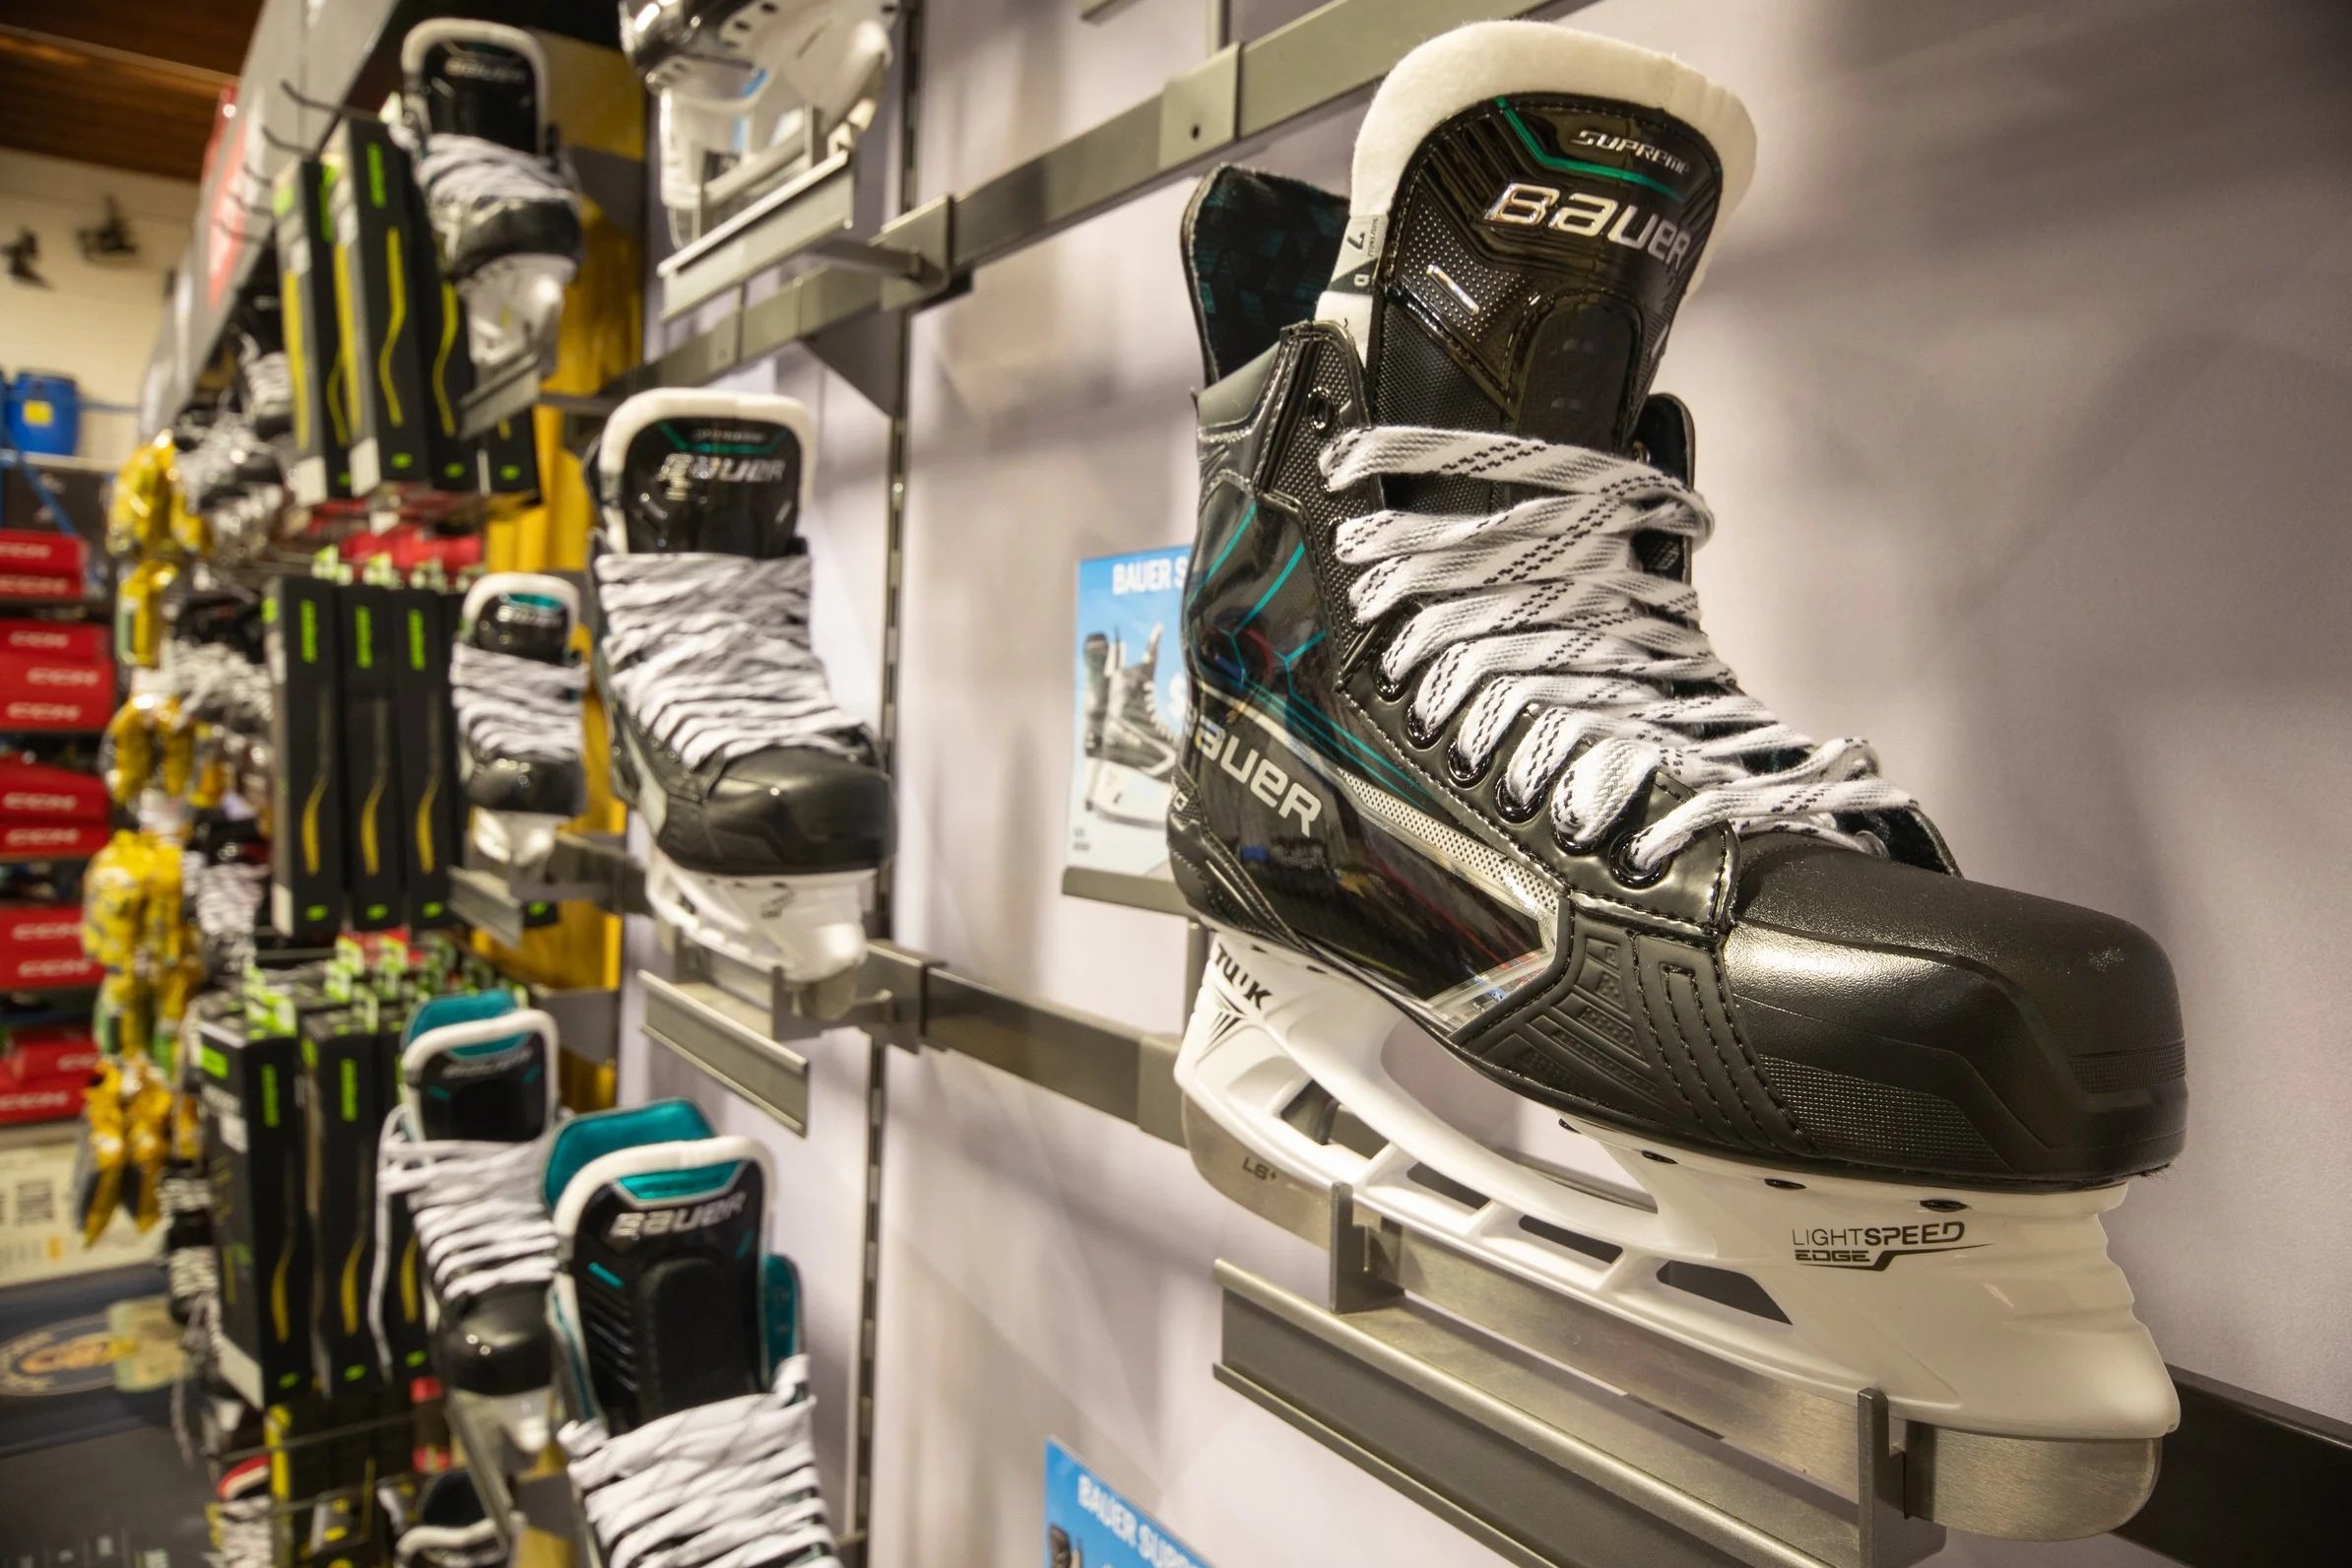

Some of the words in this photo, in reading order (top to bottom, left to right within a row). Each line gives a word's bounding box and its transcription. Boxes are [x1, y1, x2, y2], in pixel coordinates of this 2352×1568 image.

[1346, 231, 1365, 250] 7
[1112, 560, 1172, 596] BAUER
[1194, 714, 1322, 837] AUER
[1792, 1221, 1965, 1246] LIGHTSPEED
[1795, 1249, 1870, 1263] EDGE
